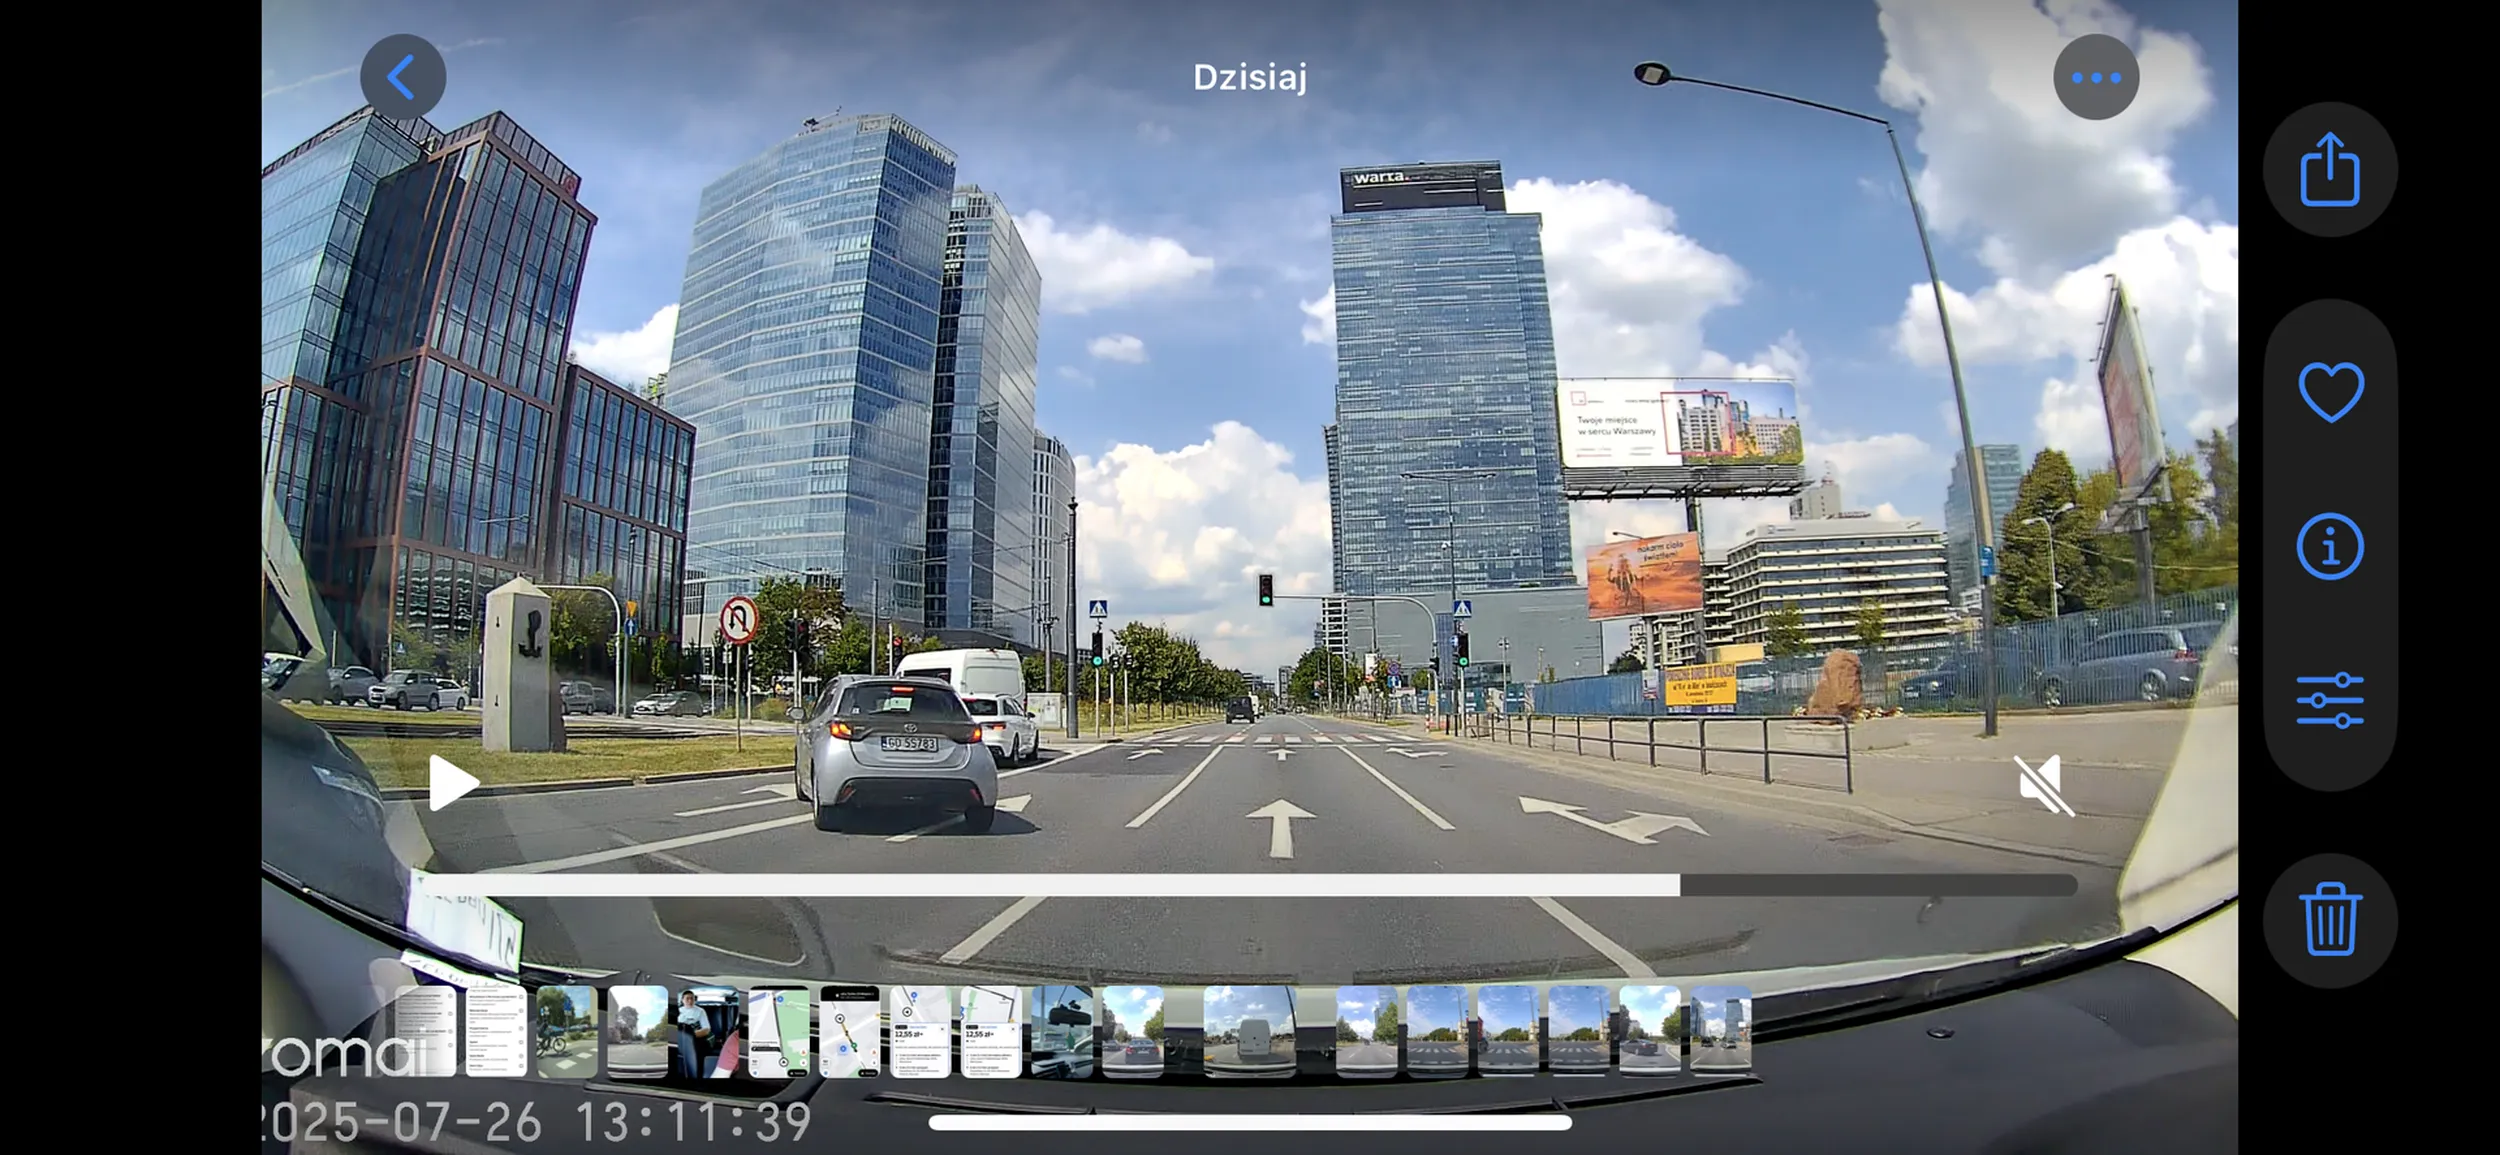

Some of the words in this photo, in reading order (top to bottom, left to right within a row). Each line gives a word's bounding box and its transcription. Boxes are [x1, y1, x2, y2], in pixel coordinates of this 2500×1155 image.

[1577, 416, 1603, 425] Twoje
[1605, 416, 1638, 425] miejsce
[1613, 427, 1656, 436] Warszawy
[895, 1030, 913, 1038] 12,55
[966, 1030, 983, 1038] 12,55
